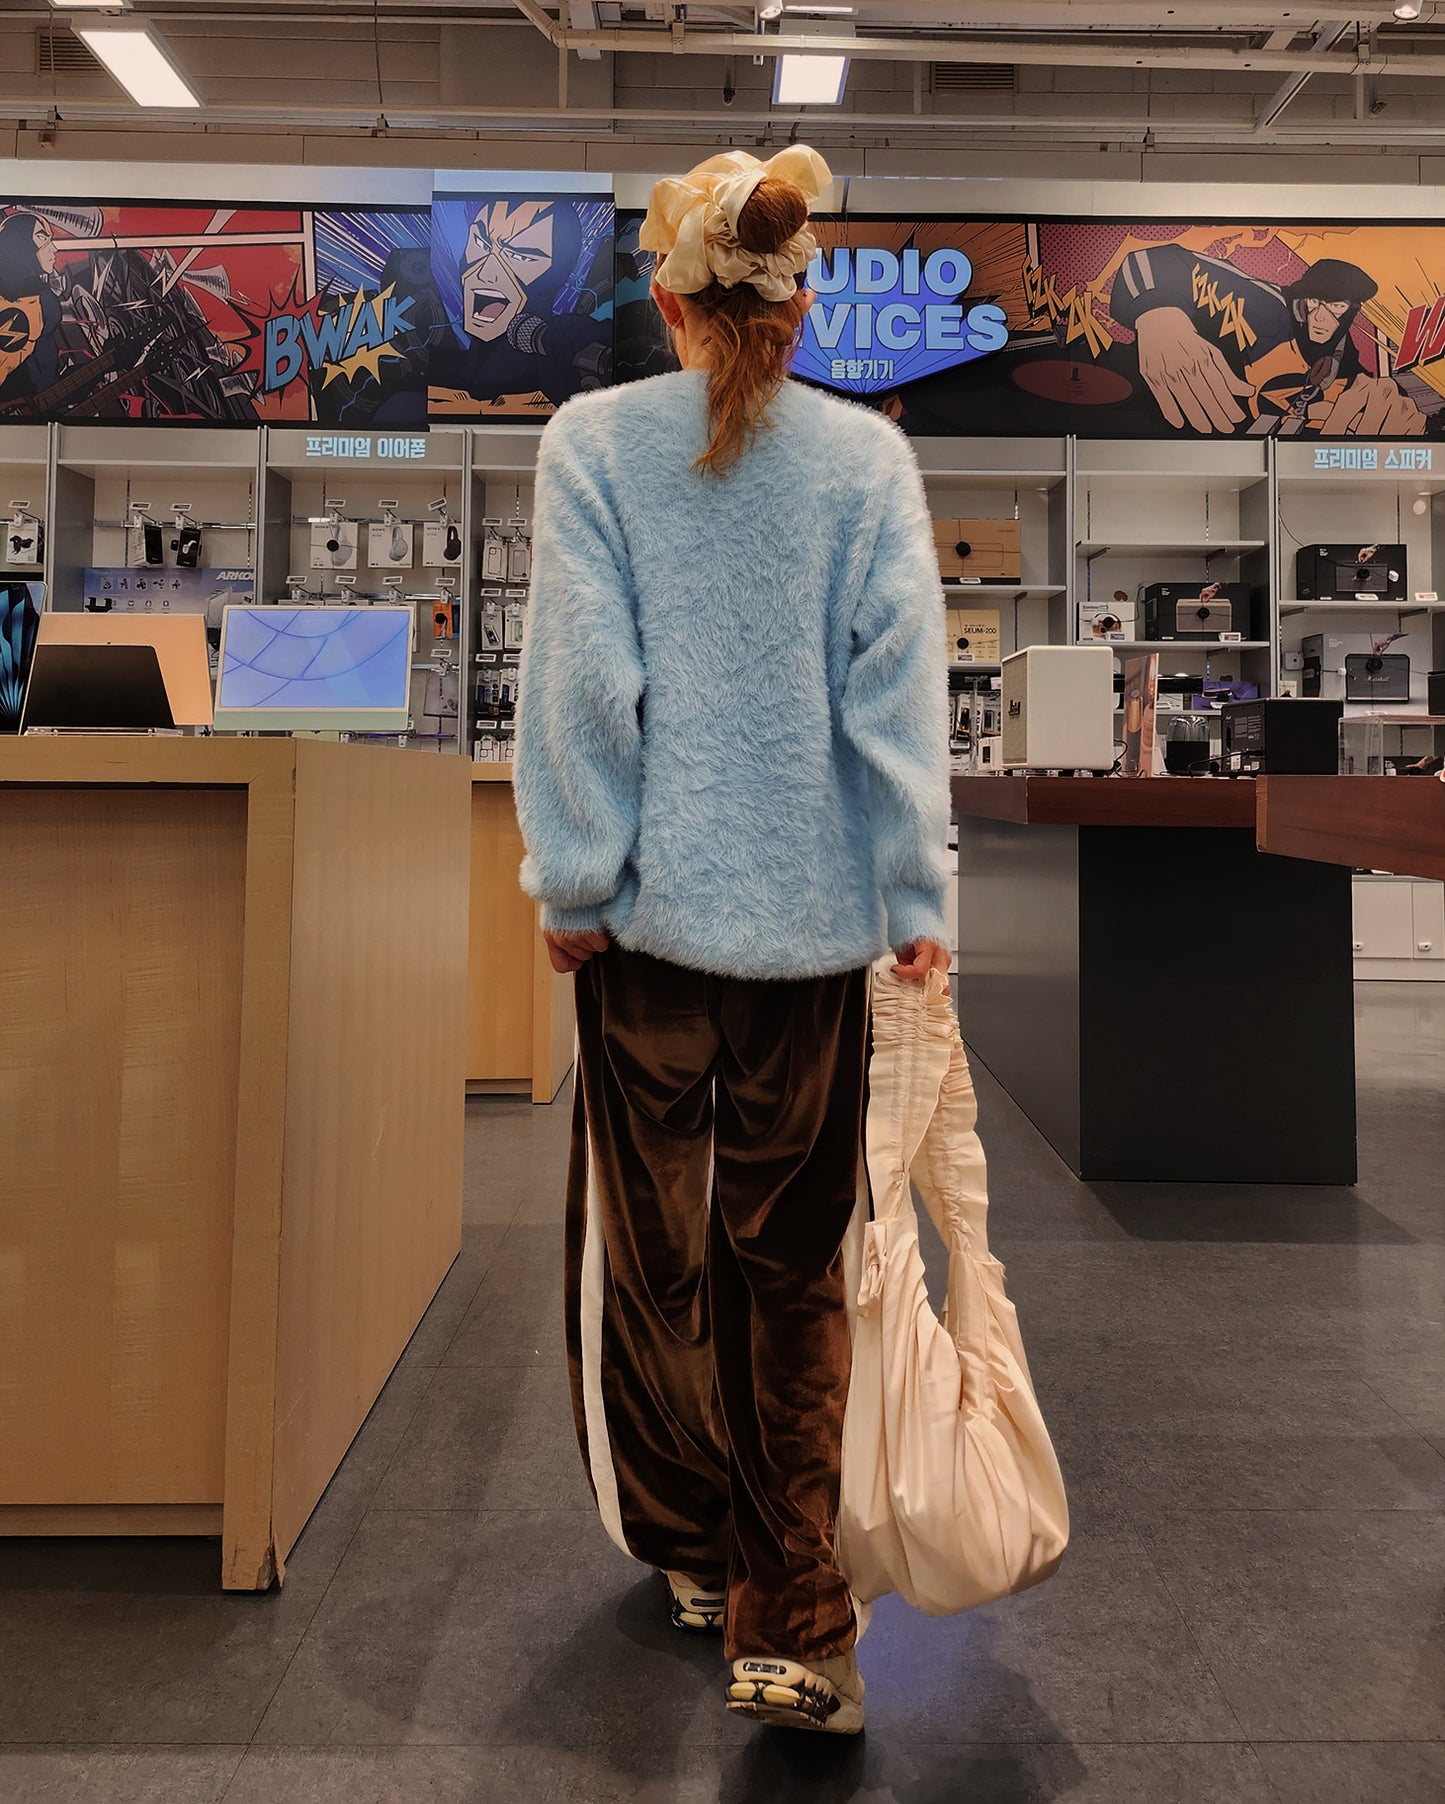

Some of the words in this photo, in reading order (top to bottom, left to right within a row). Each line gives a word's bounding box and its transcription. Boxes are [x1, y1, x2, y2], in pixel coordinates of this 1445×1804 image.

[805, 247, 973, 297] UDIO
[800, 302, 1010, 352] VICES
[830, 358, 895, 381] 음향기기
[306, 436, 371, 458] 프리미엄
[376, 437, 426, 459] 이어폰
[1314, 448, 1378, 470] 프리미엄
[1384, 448, 1432, 470] 스피커
[215, 571, 255, 582] ARKO
